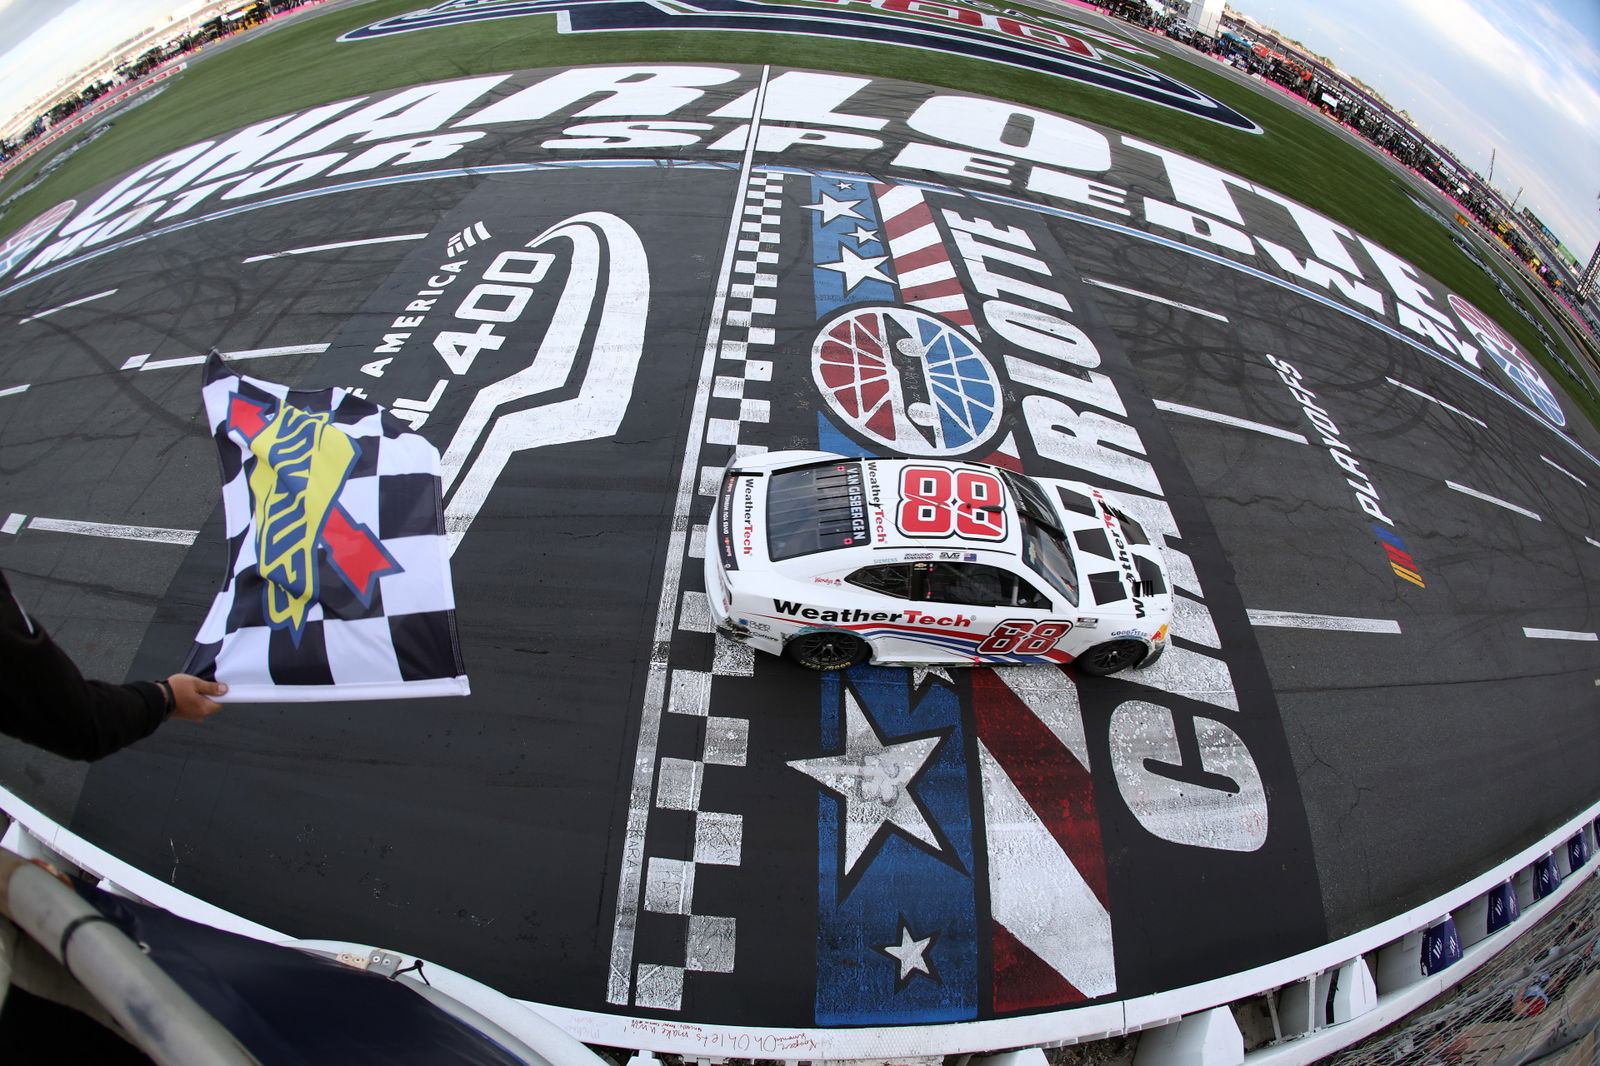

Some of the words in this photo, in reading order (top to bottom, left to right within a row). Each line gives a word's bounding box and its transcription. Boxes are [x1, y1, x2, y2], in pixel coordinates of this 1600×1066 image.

[59, 64, 1459, 332] CHARLOTTE
[15, 131, 487, 278] MOTOR
[540, 121, 1482, 370] SPEEDWAY
[360, 260, 468, 378] AMERICA
[847, 467, 859, 485] VAN
[1266, 353, 1395, 527] PLAYOFFS
[743, 478, 755, 556] WeatherTech
[848, 486, 866, 540] GISBERGEN
[868, 461, 888, 543] WeatherTech
[895, 464, 1007, 541] 88
[773, 598, 973, 628] WeatherTech
[975, 619, 1073, 655] 88
